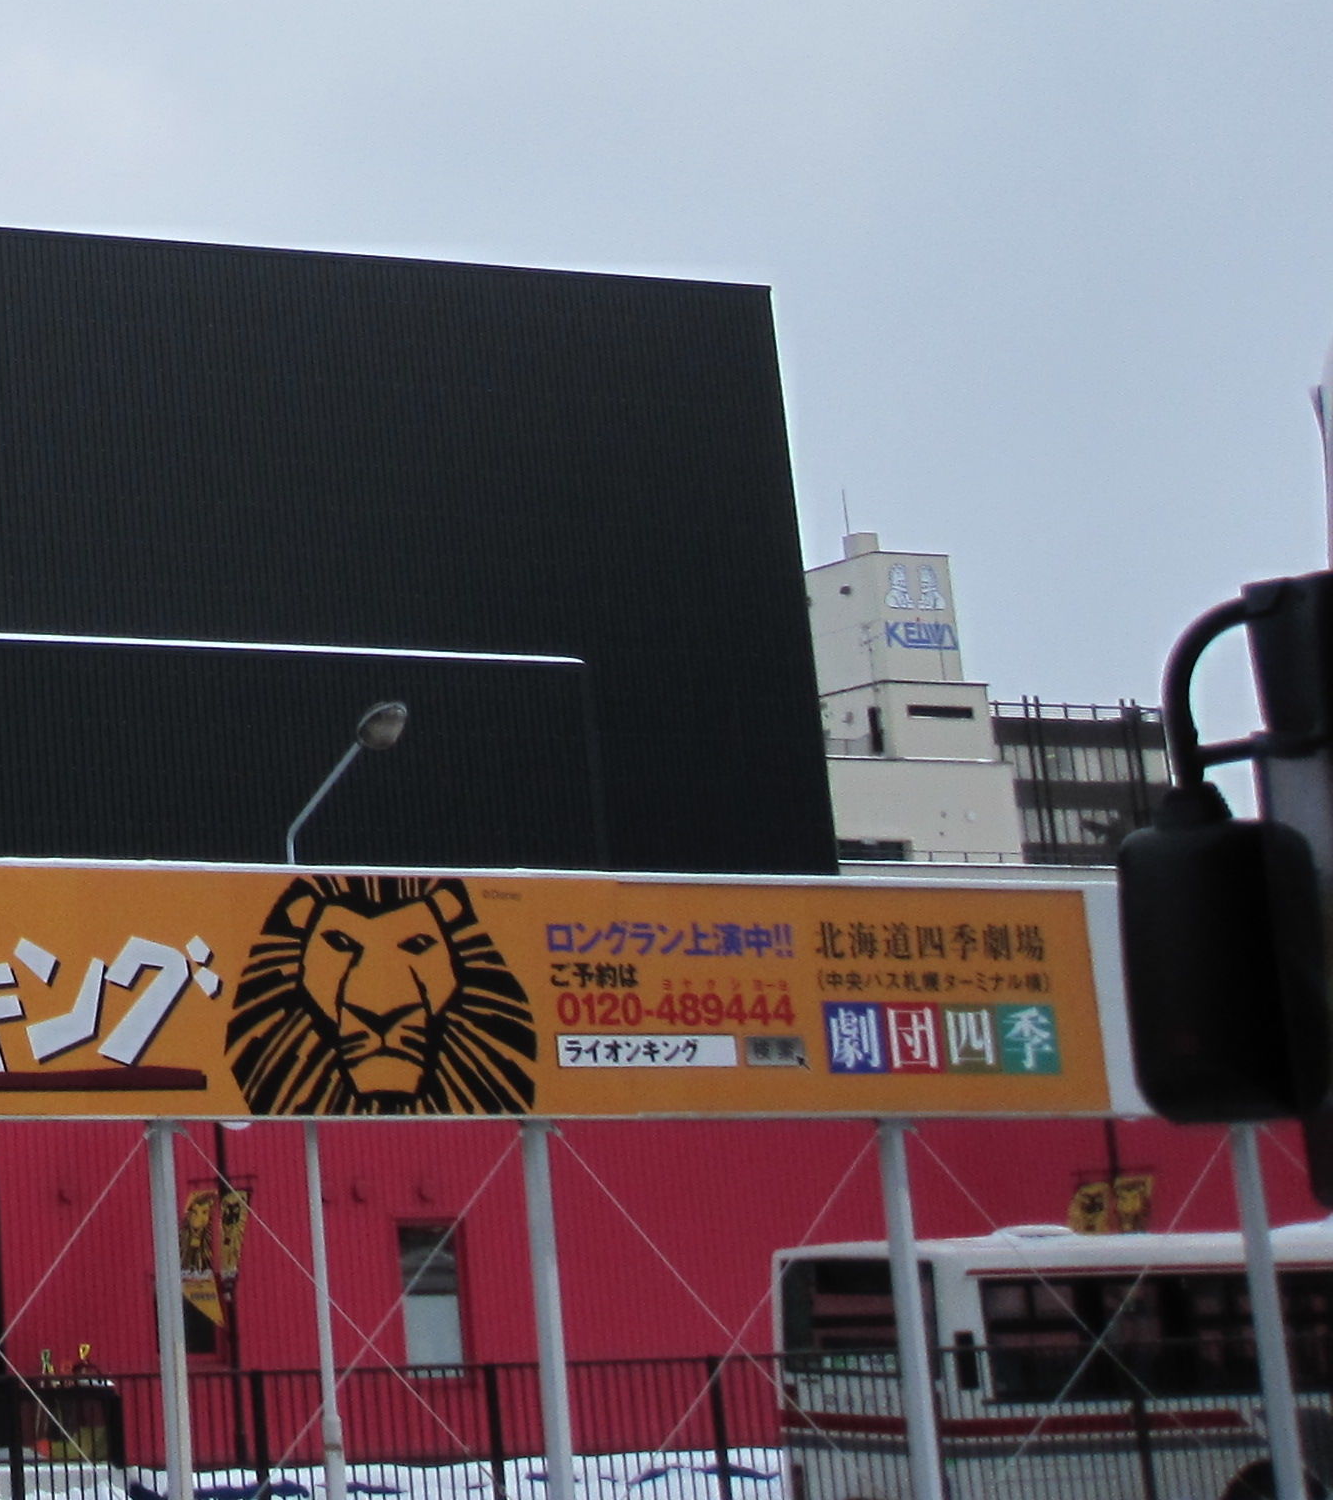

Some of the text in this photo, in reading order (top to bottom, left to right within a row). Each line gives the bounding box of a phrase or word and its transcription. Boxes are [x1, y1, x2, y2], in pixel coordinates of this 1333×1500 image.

[816, 921, 1046, 962] 北海道四季劇場
[549, 962, 639, 989] ご予約は
[556, 992, 797, 1027] 0120-489444
[564, 1038, 699, 1063] ライオンキング
[827, 1006, 1057, 1070] 劇団四季
